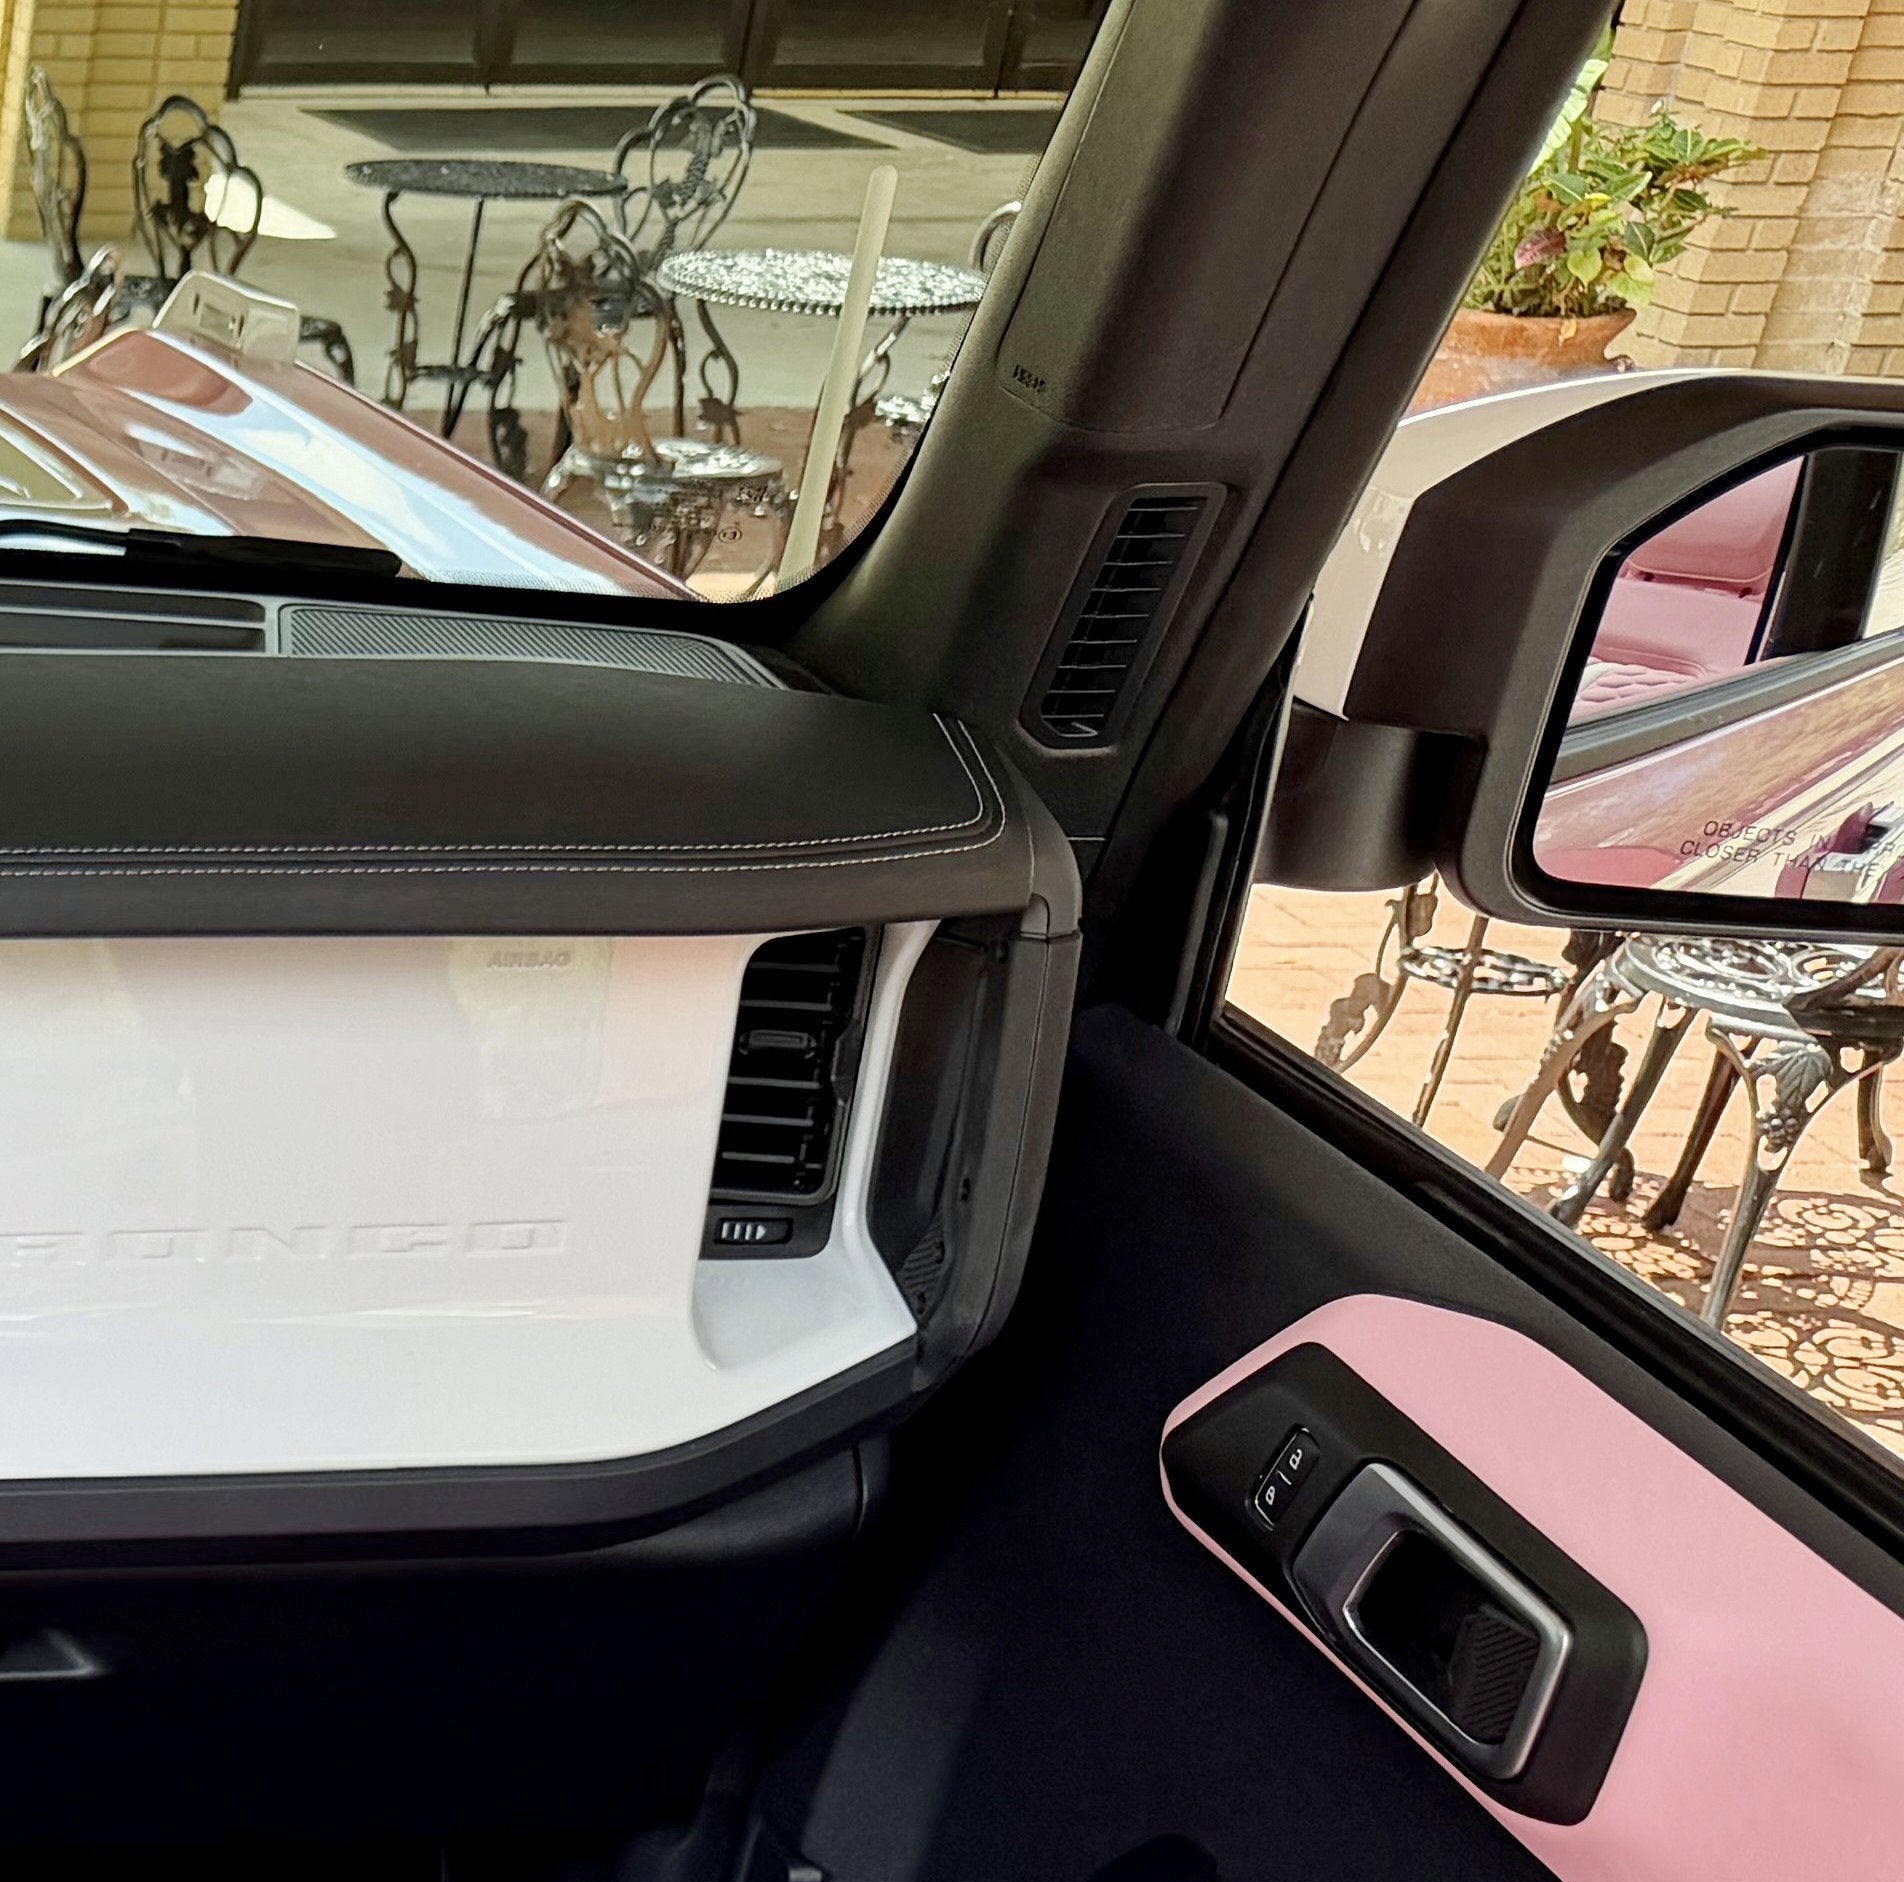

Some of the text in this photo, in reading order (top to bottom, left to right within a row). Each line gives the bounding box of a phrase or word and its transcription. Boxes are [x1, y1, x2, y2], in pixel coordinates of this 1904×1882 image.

[1703, 820, 1832, 850] OBJECTS IN
[1679, 839, 1760, 863] CLOSER
[1773, 851, 1827, 873] THAN
